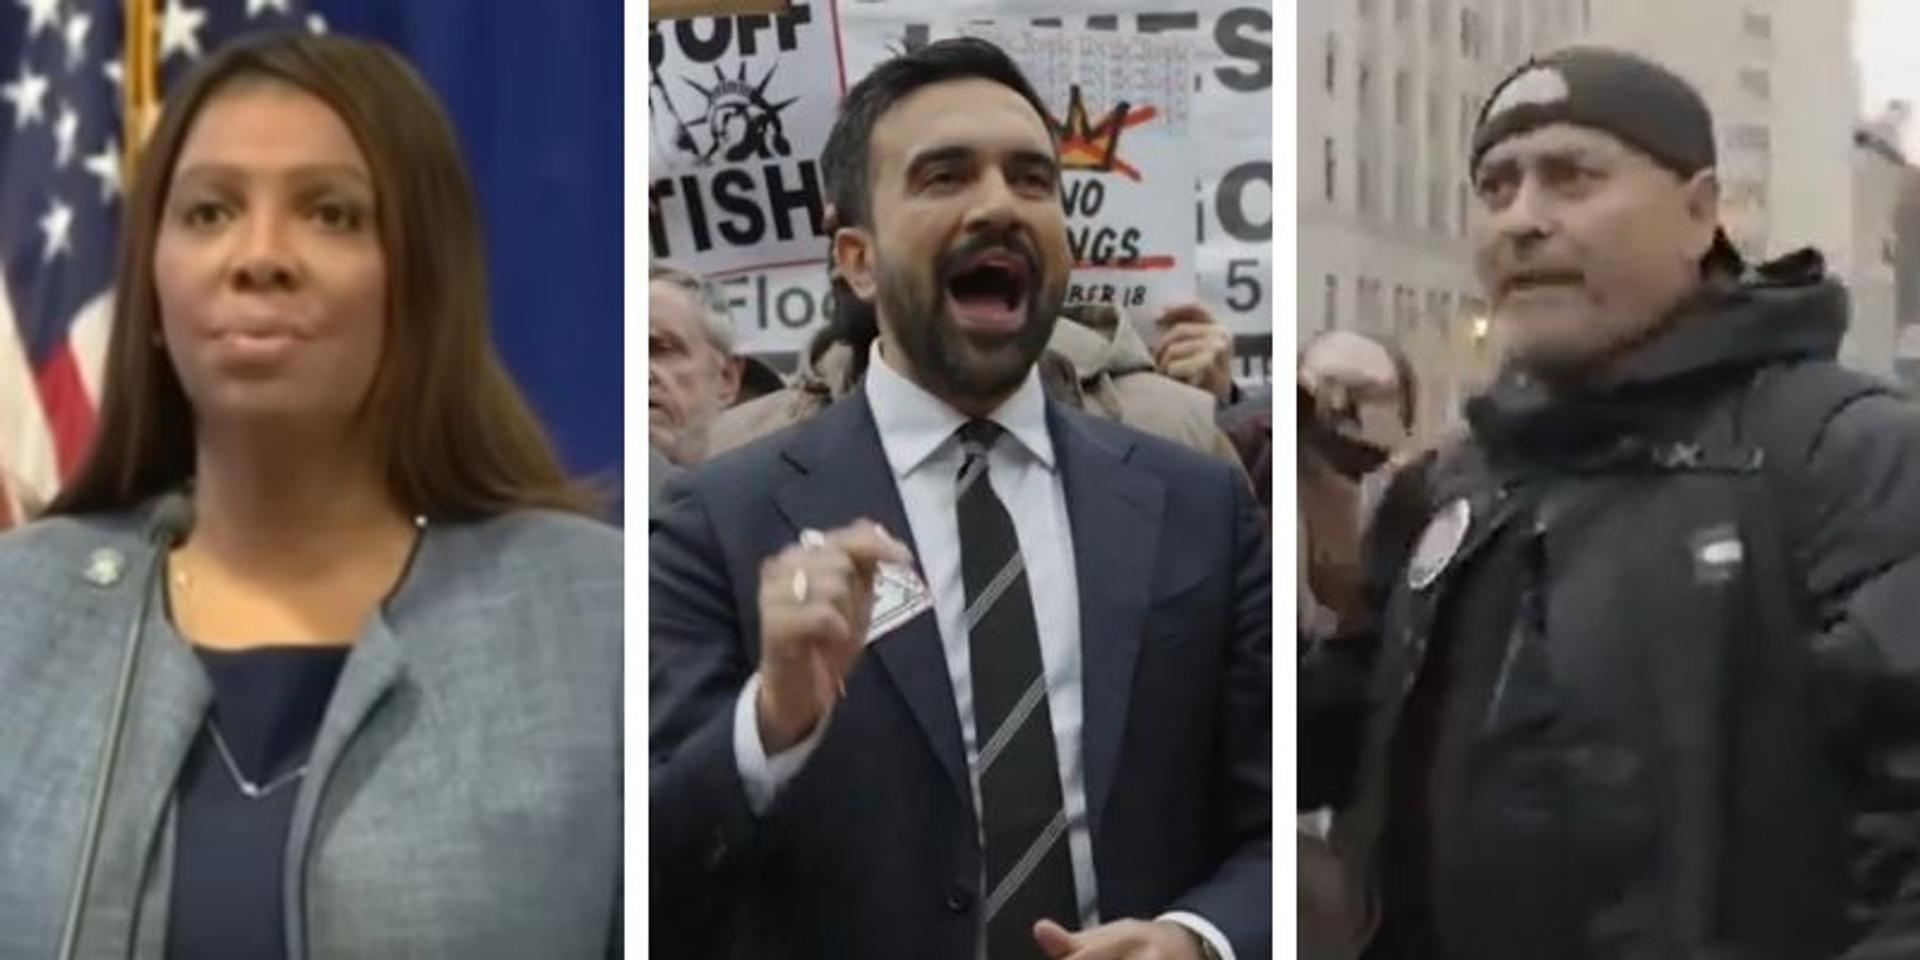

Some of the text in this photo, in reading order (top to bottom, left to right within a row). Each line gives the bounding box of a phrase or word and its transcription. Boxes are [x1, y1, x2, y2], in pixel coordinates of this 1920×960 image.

[1066, 226, 1141, 265] NGS
[1068, 283, 1147, 307] BER 18
